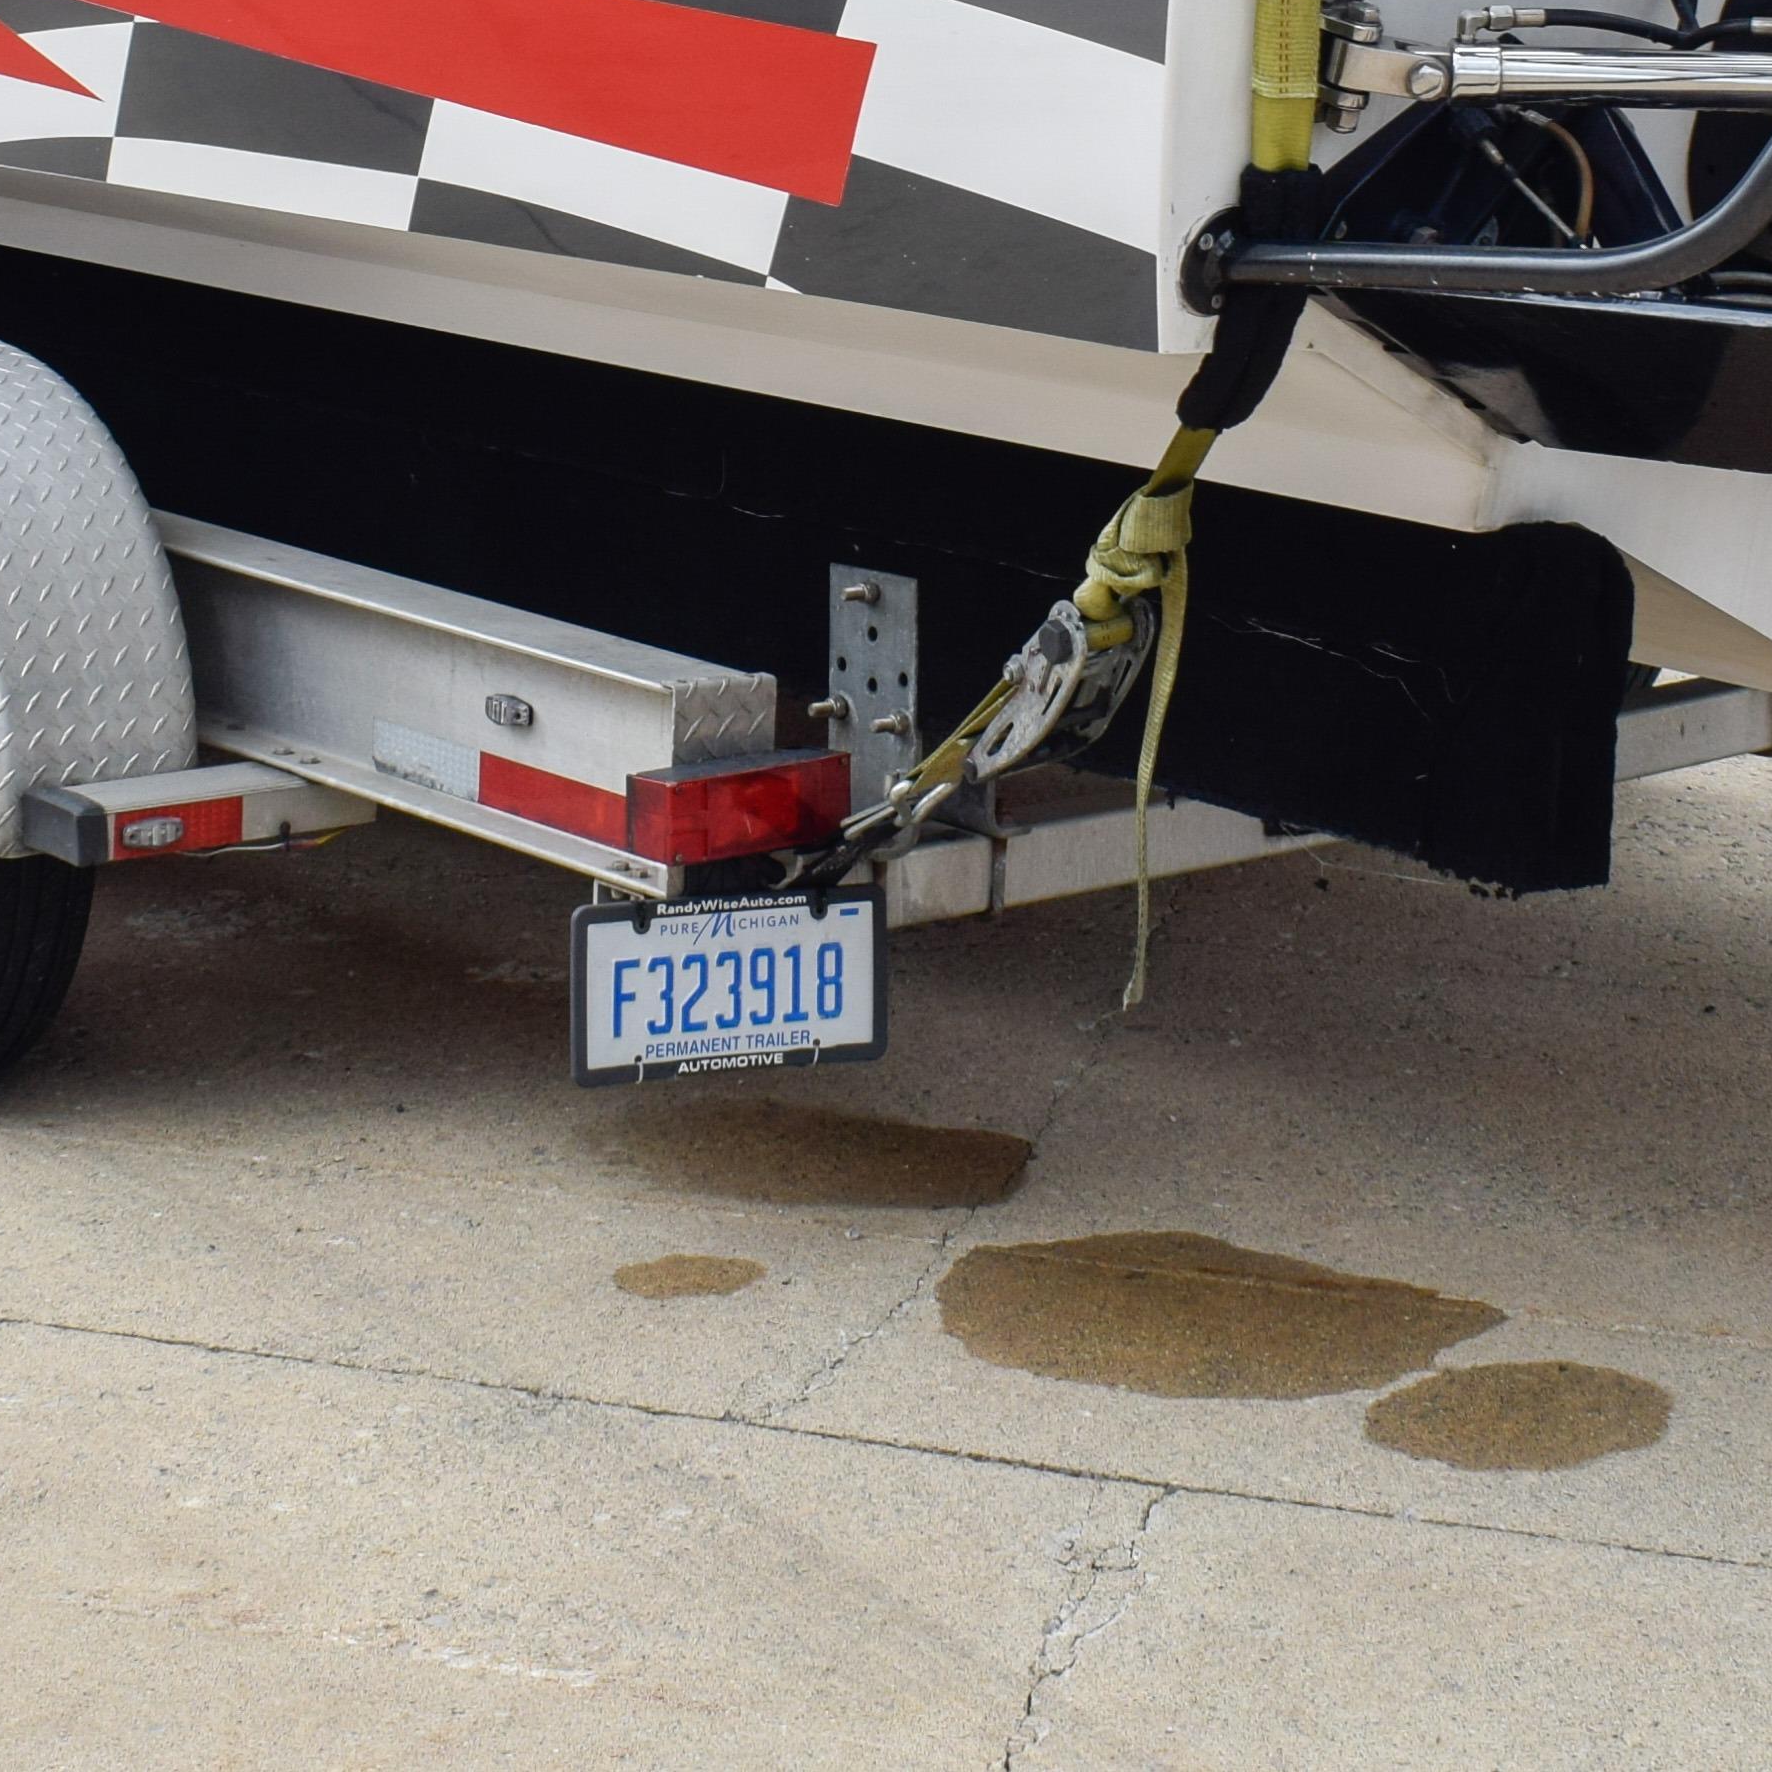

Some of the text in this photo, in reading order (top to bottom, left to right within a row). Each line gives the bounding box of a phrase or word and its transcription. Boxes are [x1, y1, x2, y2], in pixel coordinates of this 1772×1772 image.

[656, 894, 808, 916] RandyWiseAuto.com
[659, 912, 801, 946] PURE MICHIGAN
[612, 941, 844, 1039] F323918
[645, 1029, 811, 1059] PERMANENT TRAILER
[677, 1052, 784, 1074] AUTOMOTIVE
